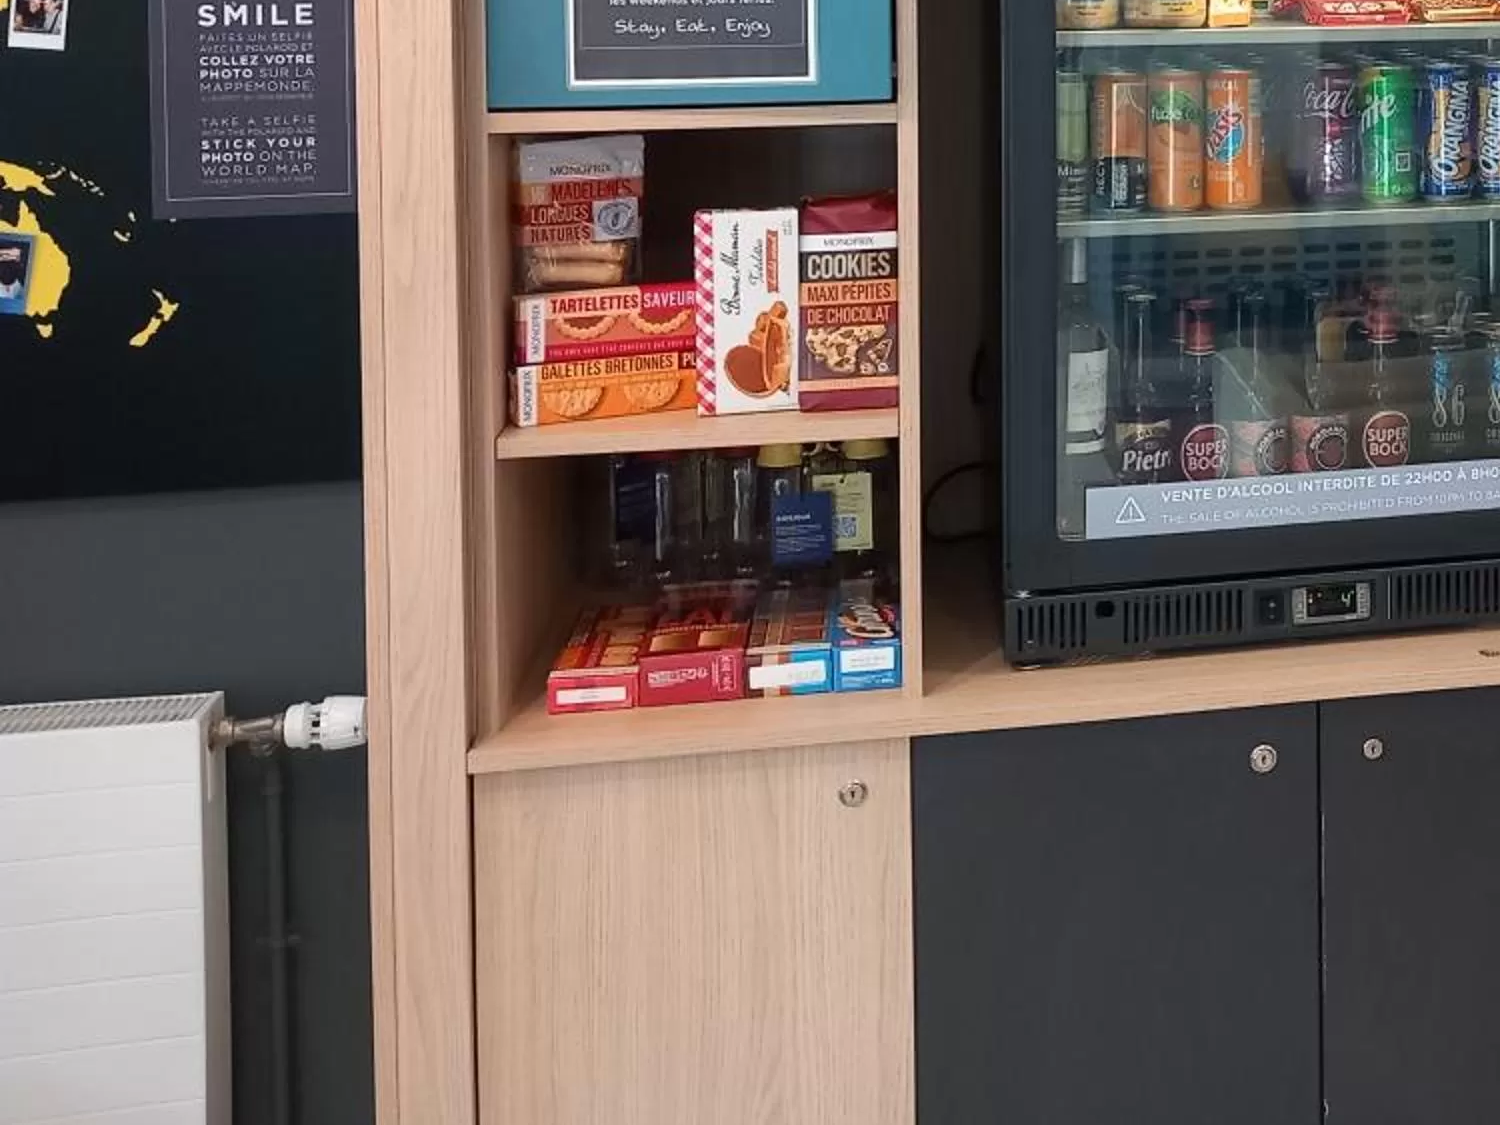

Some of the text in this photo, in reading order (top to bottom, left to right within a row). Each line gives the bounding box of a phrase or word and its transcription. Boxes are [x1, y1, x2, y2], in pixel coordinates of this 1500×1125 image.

[198, 2, 313, 26] SMILE
[725, 18, 771, 38] Enjoy
[200, 55, 314, 66] COLLEZ VOTRE
[200, 67, 314, 79] PHOTO SUR LA
[202, 115, 316, 127] TAKE A SELFIE
[1434, 80, 1469, 177] ORANGINA
[202, 137, 315, 149] STICK YOUR
[202, 150, 317, 163] PHOTO ON THE
[202, 165, 267, 177] WORLD
[531, 204, 589, 224] LONGUES
[531, 226, 590, 242] NATURES
[823, 237, 875, 246] MONOPRIX
[808, 252, 890, 279] COOKIES
[808, 281, 891, 302] MAXI PÉPITES
[551, 294, 638, 313] TARTELETTES
[808, 305, 890, 324] DE CHOCOLAT
[542, 354, 673, 380] GALETTES BRETONNES
[1161, 489, 1212, 503] VENTE
[1217, 483, 1293, 499] D'ALCOOL
[1300, 476, 1376, 492] INTERDITE
[1381, 474, 1400, 486] DE
[1405, 470, 1452, 485] 22H00
[1161, 514, 1185, 524] THE
[1189, 511, 1221, 523] SALE
[1224, 510, 1240, 520] OF
[1245, 505, 1302, 518] ALCOHOL
[1322, 497, 1394, 514] PROHIBITED
[1398, 494, 1432, 508] FROM
[1468, 490, 1482, 503] TO
